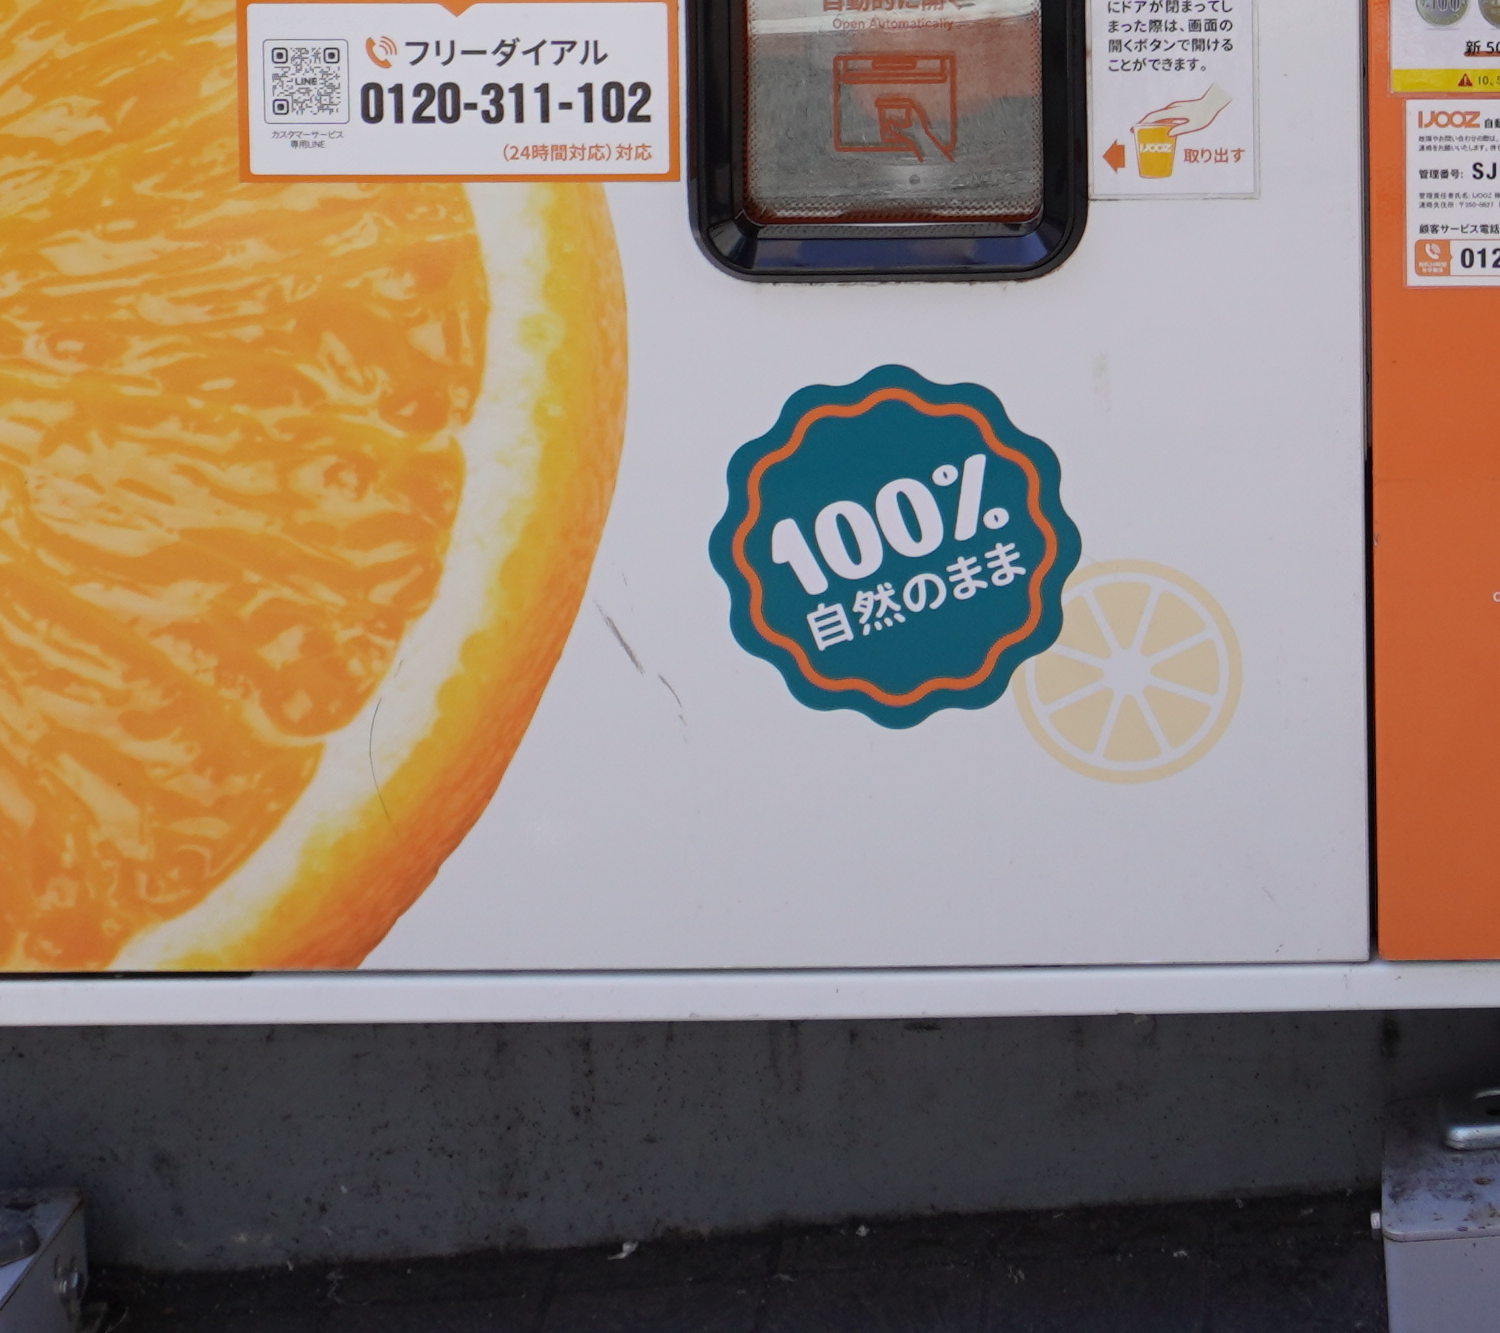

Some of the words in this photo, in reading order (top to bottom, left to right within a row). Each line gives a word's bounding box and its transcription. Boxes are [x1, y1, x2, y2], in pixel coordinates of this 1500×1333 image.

[832, 17, 866, 31] Open
[869, 17, 954, 31] Automatically
[405, 39, 608, 67] フリーダイアル
[1109, 58, 1206, 72] ことができます。
[360, 81, 652, 124] 0120-311-102
[1184, 148, 1245, 163] 取り出す
[771, 454, 1009, 596] 100%
[806, 542, 1026, 651] 自然のまま
